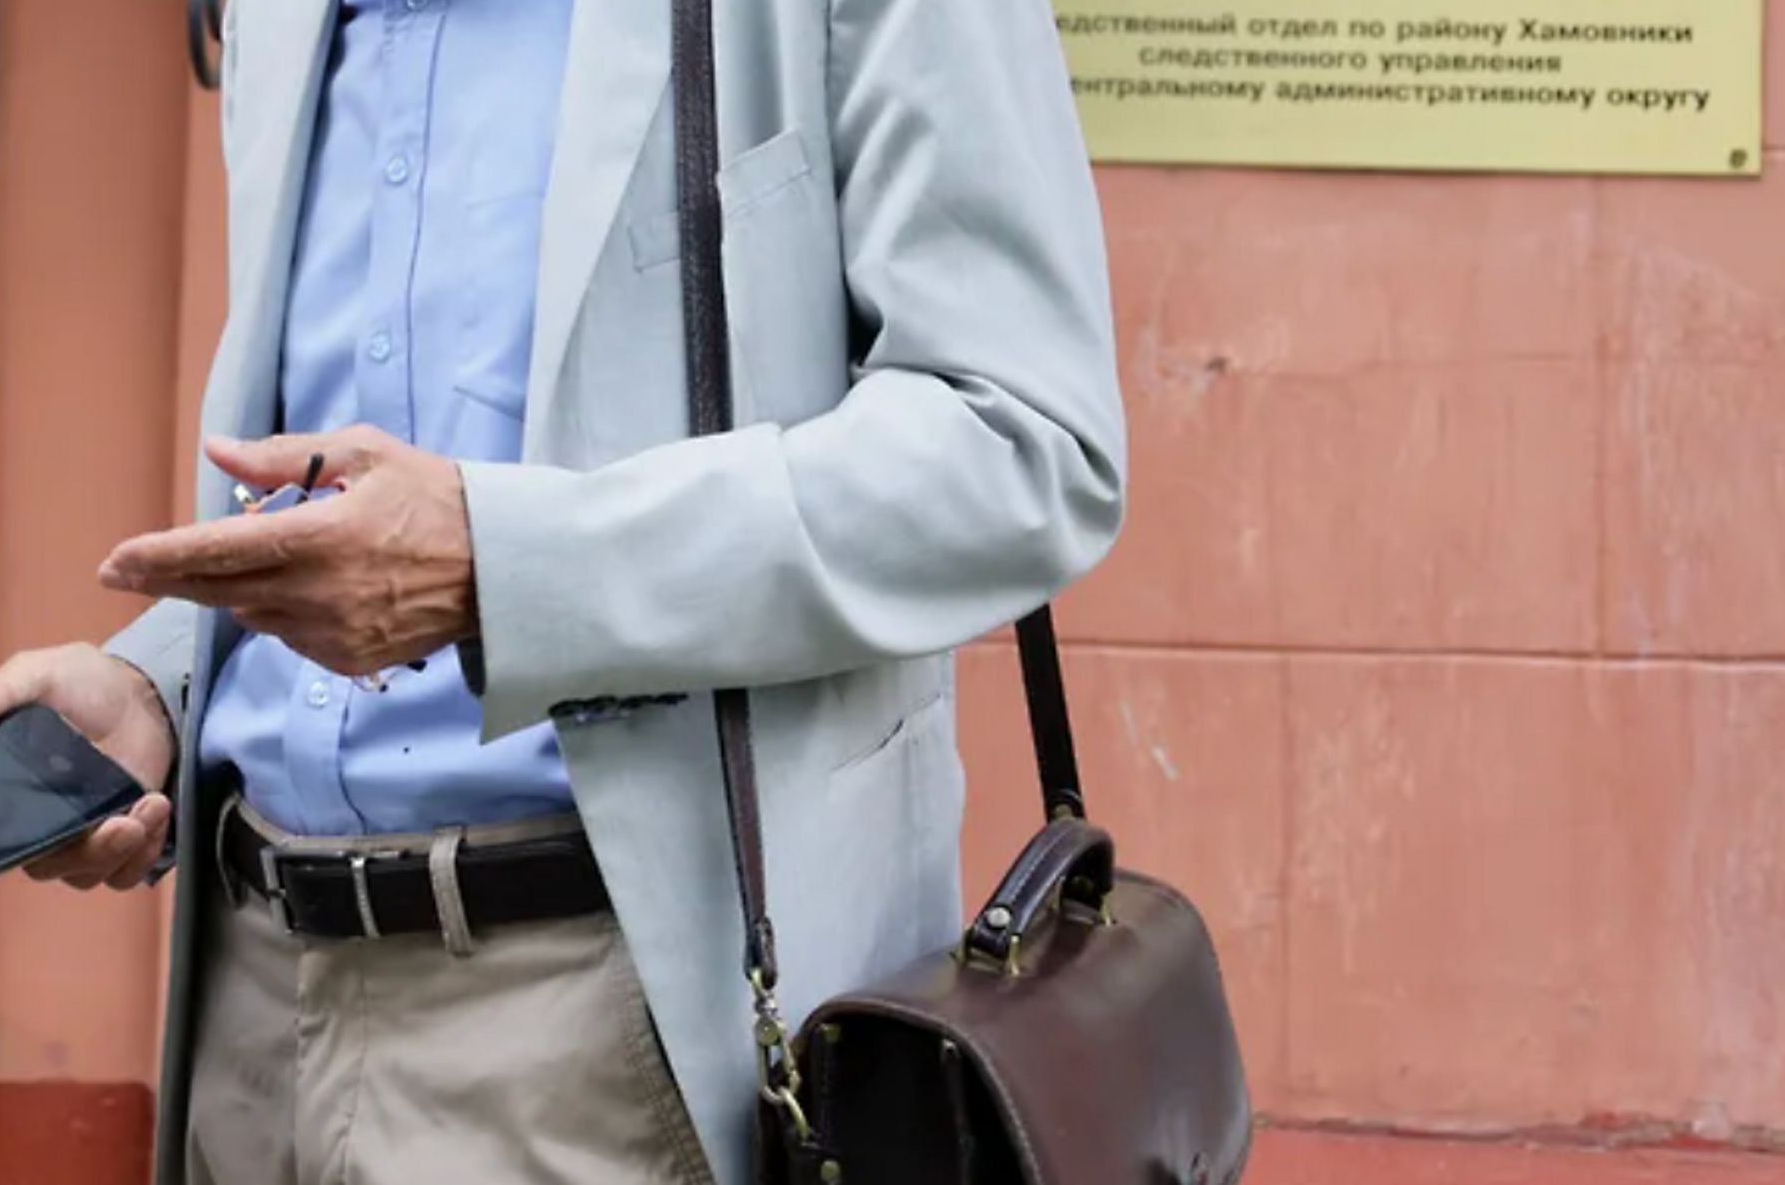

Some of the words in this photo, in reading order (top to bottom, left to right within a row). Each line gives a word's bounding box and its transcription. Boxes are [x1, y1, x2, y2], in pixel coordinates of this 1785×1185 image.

[1247, 18, 1337, 38] отдел
[1349, 22, 1386, 40] по
[1396, 18, 1508, 45] району
[1519, 18, 1694, 43] Хамовники
[1138, 46, 1368, 68] следственного
[1379, 52, 1562, 74] управления
[1275, 81, 1596, 110] административному
[1606, 87, 1711, 112] округу
